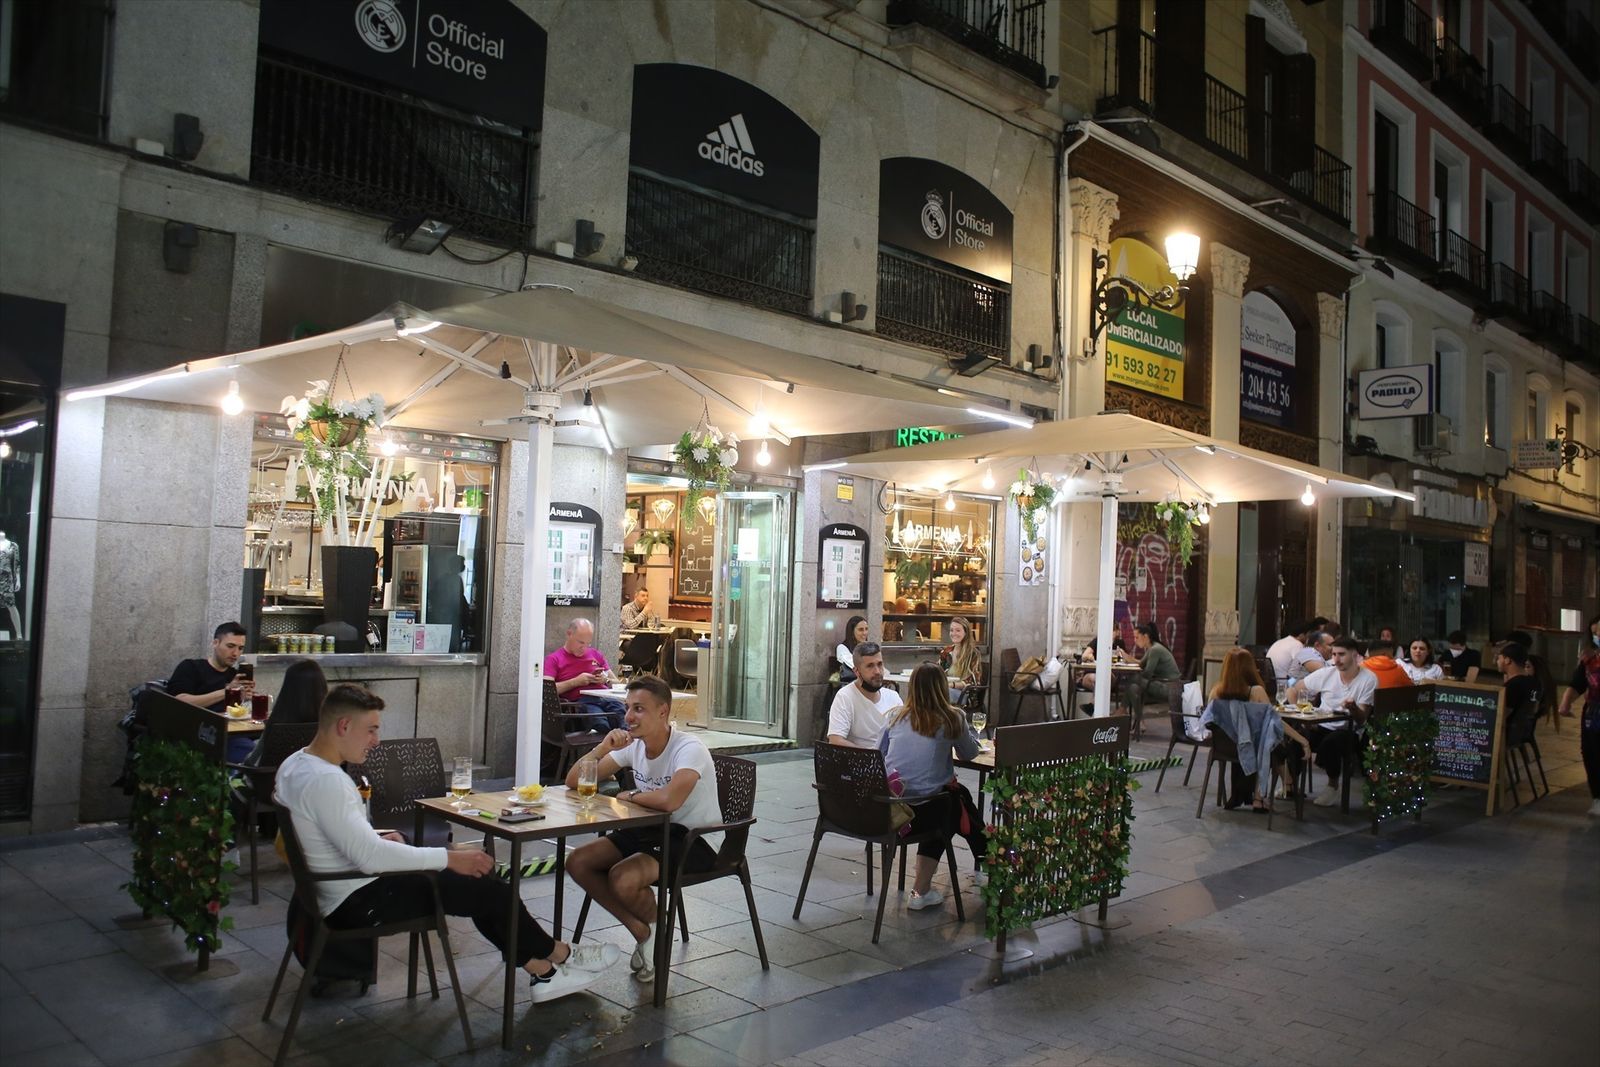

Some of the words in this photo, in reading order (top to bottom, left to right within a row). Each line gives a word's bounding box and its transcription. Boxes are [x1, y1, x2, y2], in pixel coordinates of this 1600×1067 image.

[428, 14, 504, 59] Official
[426, 41, 487, 80] Store
[698, 141, 764, 176] adidas
[956, 209, 993, 237] Official
[955, 228, 985, 251] Store
[1127, 306, 1158, 329] LOCAL
[1107, 321, 1183, 355] OMERCIALIZADO
[1245, 326, 1265, 346] Seeker
[1106, 351, 1119, 369] 91
[1123, 356, 1144, 375] 593
[1147, 362, 1160, 380] 82
[1164, 368, 1176, 384] 27
[1248, 374, 1264, 400] 204
[1266, 380, 1277, 404] 43
[1280, 384, 1290, 407] 56
[1371, 386, 1416, 398] PADILLA
[897, 427, 965, 447] RESTA
